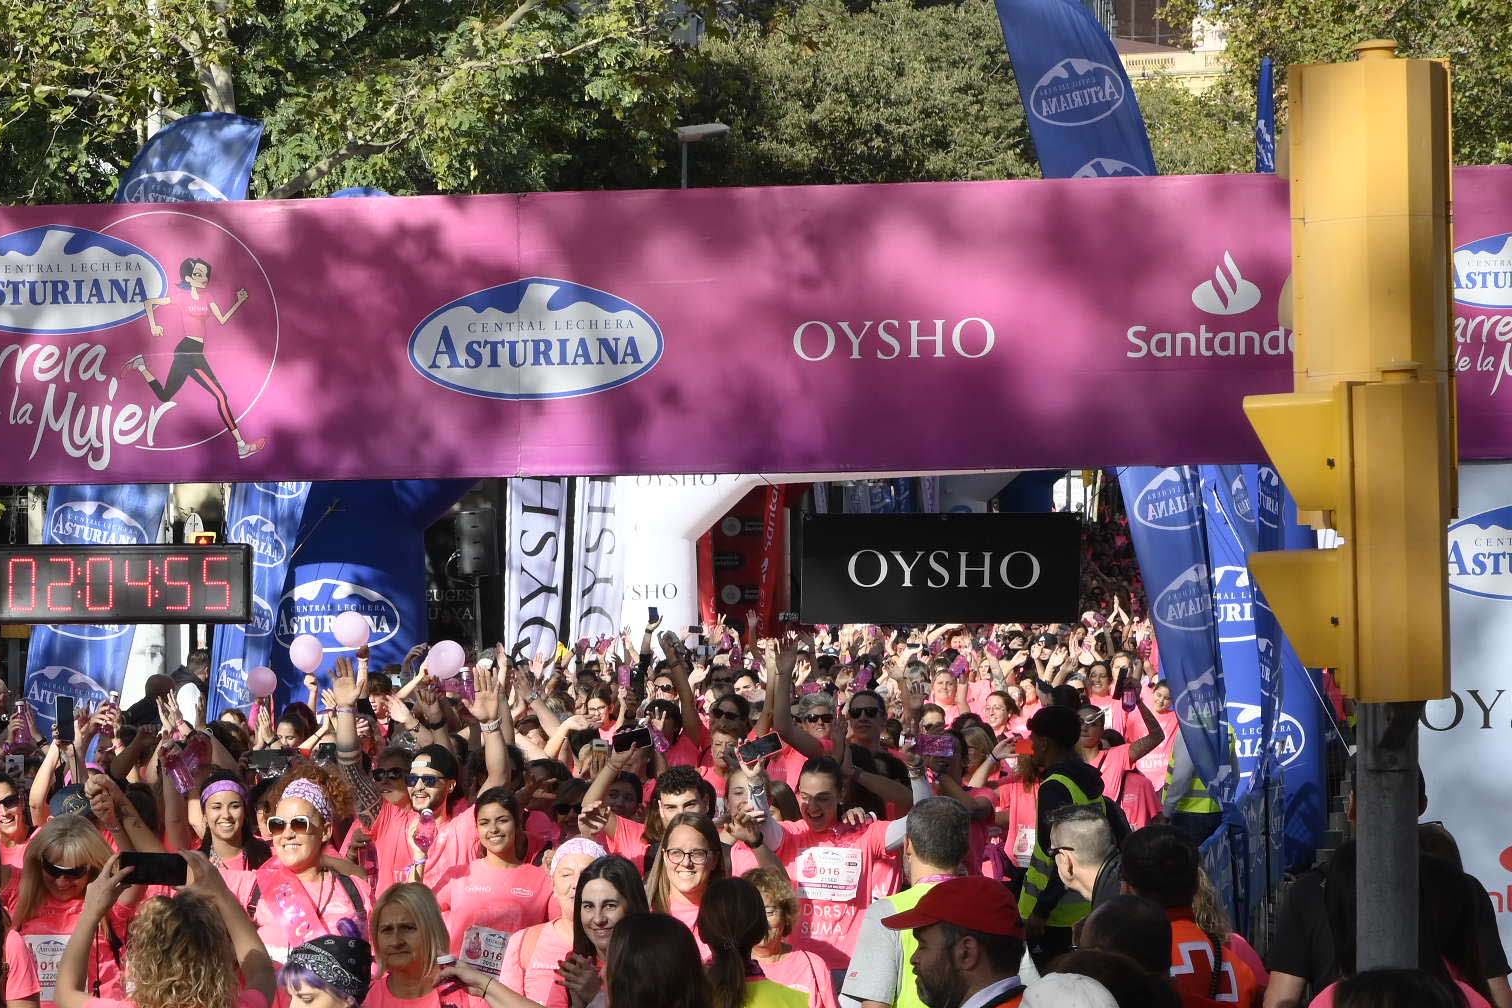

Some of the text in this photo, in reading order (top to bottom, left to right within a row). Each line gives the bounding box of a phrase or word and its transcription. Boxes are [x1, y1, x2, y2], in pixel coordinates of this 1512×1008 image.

[70, 262, 143, 273] LECHERA
[428, 325, 643, 369] ASTURIANA
[468, 319, 635, 333] CENTRAL LECHERA
[792, 317, 996, 361] OYSHO
[1476, 344, 1495, 372] la
[9, 384, 33, 424] la
[29, 376, 177, 470] Mujer
[8, 555, 230, 612] 02:04:55
[846, 549, 1042, 591] OYSHO
